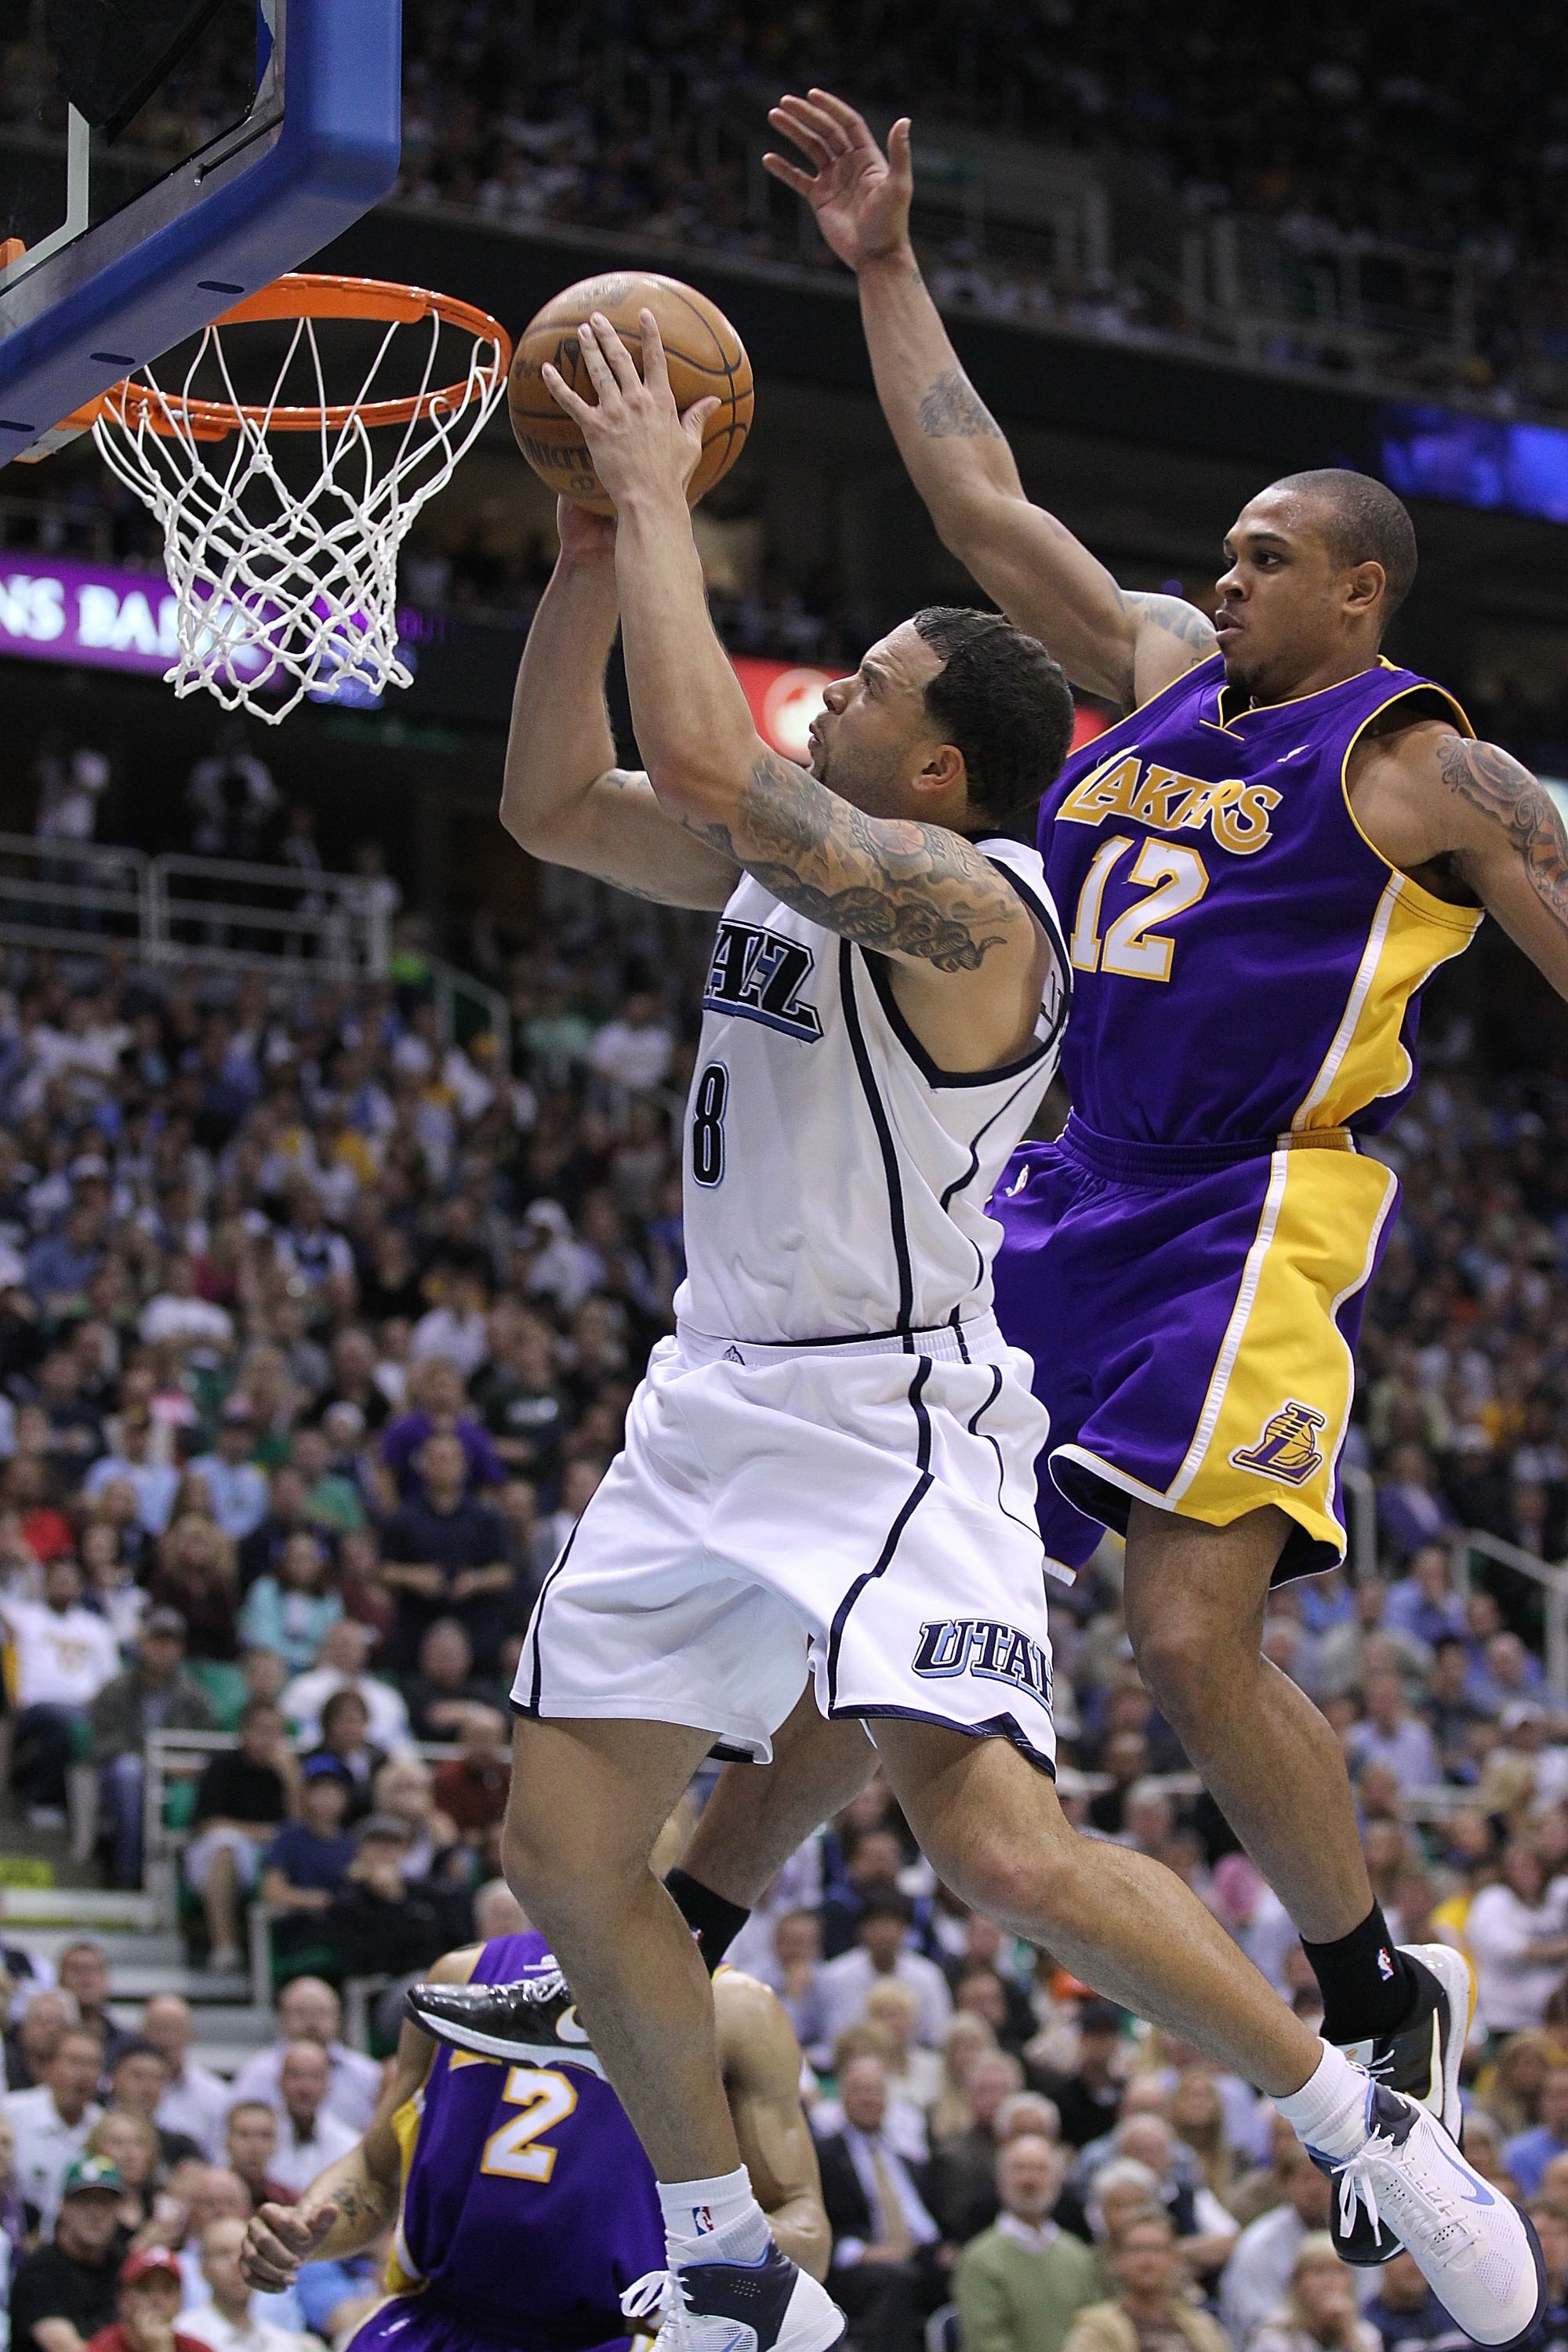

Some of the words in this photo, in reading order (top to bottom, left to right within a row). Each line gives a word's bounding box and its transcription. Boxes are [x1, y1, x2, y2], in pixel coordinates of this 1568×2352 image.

[1054, 743, 1284, 855] LAKERS
[1070, 834, 1210, 982] 12
[692, 1059, 730, 1190] 8
[480, 2066, 579, 2184] 2
